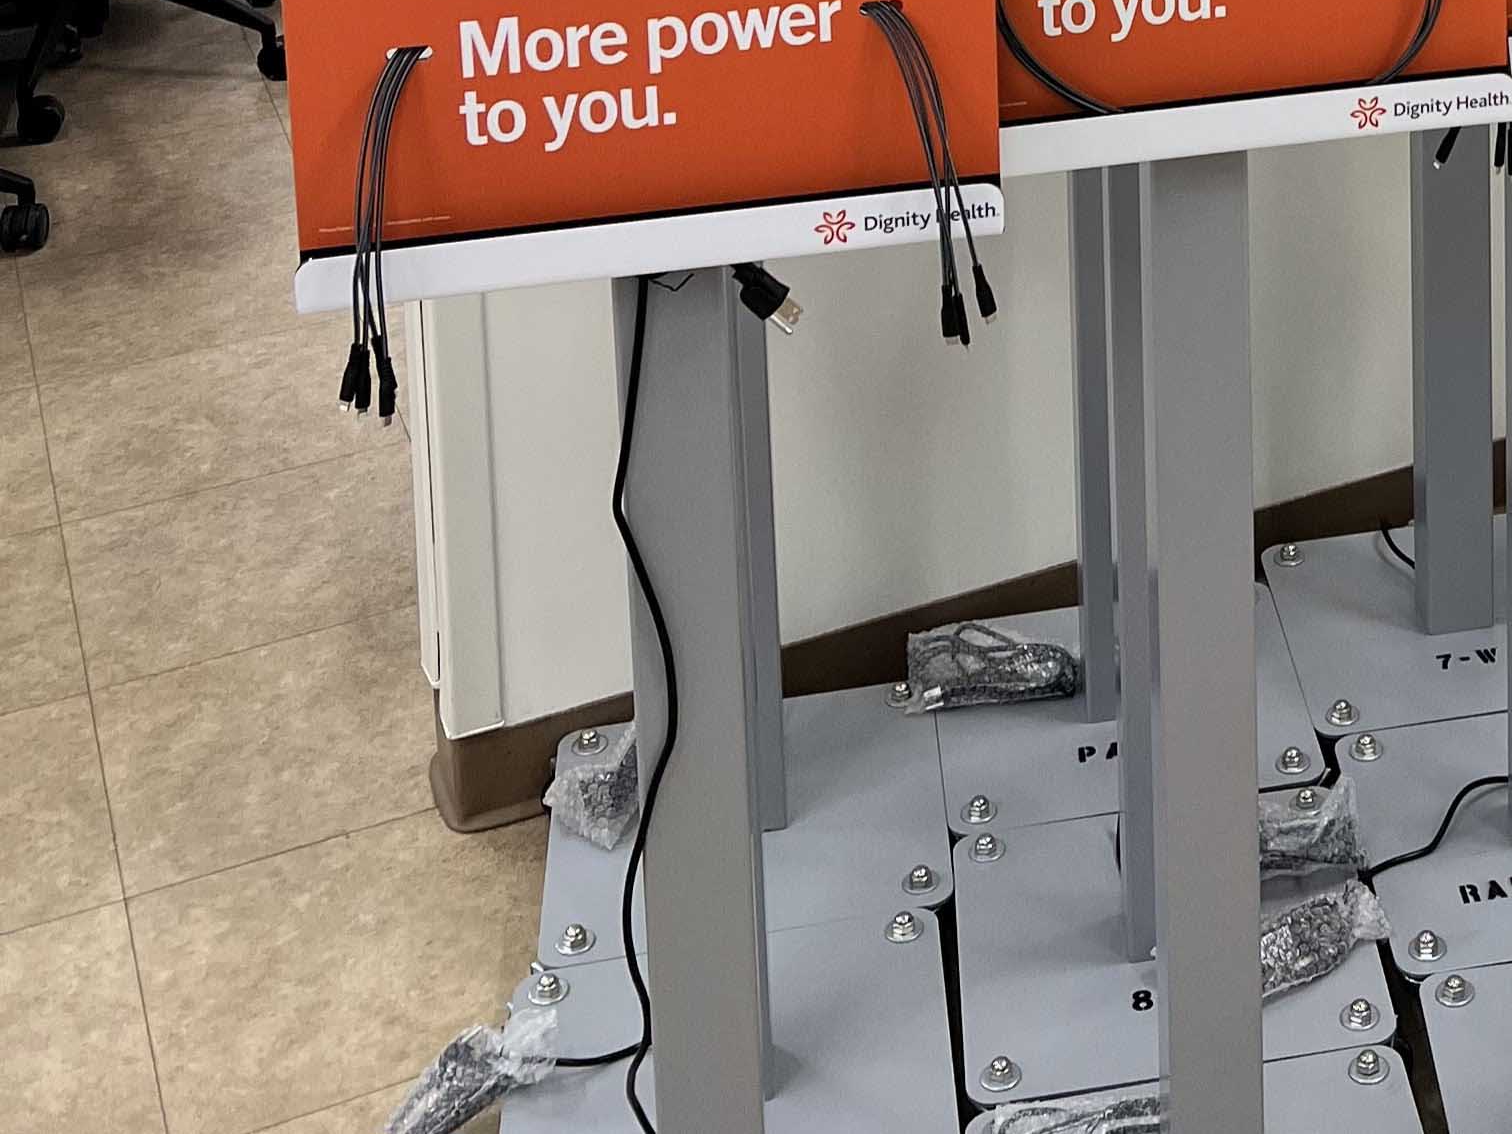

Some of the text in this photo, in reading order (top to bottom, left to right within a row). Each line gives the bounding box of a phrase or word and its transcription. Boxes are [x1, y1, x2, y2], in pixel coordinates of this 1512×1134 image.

[459, 0, 842, 79] More power
[459, 85, 678, 153] to you.
[1393, 90, 1510, 120] Dignity Health
[864, 210, 931, 234] Dignity
[1435, 647, 1497, 670] 7-W
